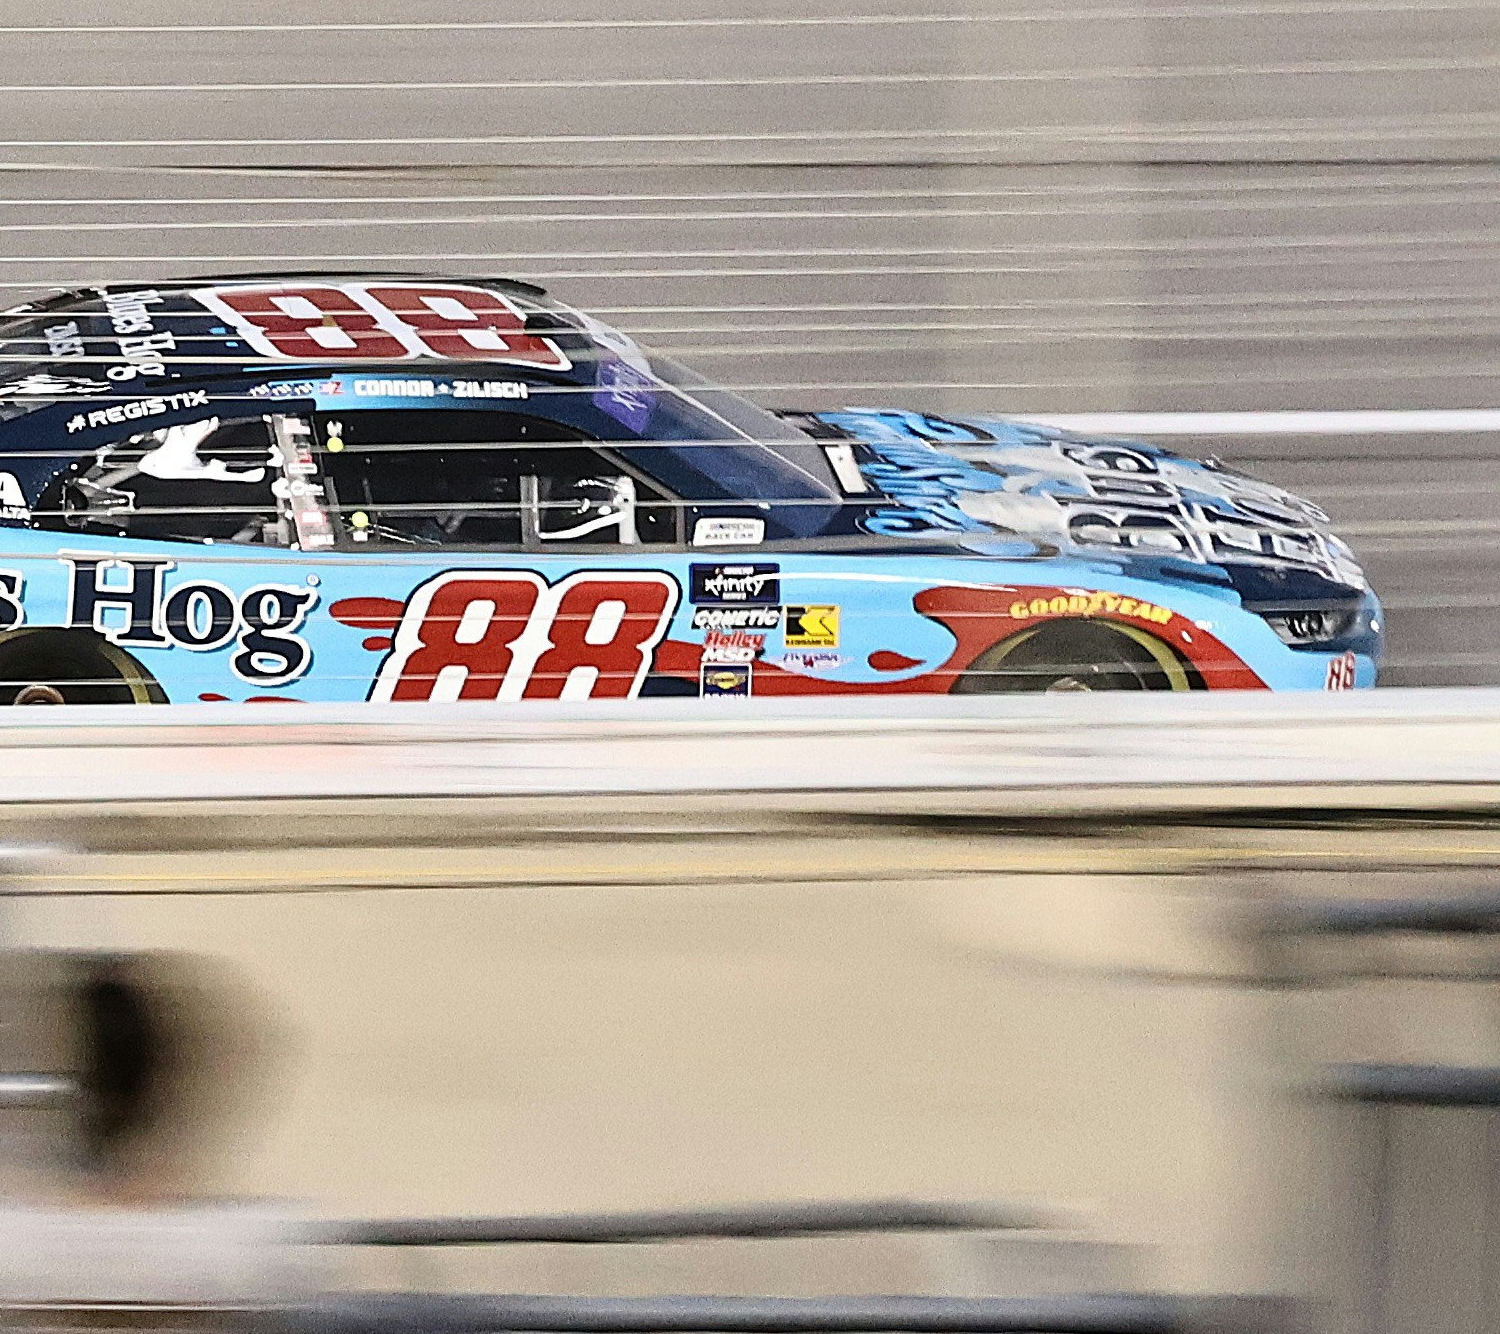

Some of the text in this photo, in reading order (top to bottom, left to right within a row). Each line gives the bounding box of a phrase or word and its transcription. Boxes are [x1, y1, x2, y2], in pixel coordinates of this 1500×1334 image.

[192, 283, 573, 371] 88
[353, 380, 528, 398] CONNOR ZILISCH
[59, 550, 317, 686] Hog
[1009, 590, 1173, 625] GOODYEAR
[366, 568, 682, 701] 88
[703, 630, 766, 650] Holley
[701, 647, 757, 663] MSD
